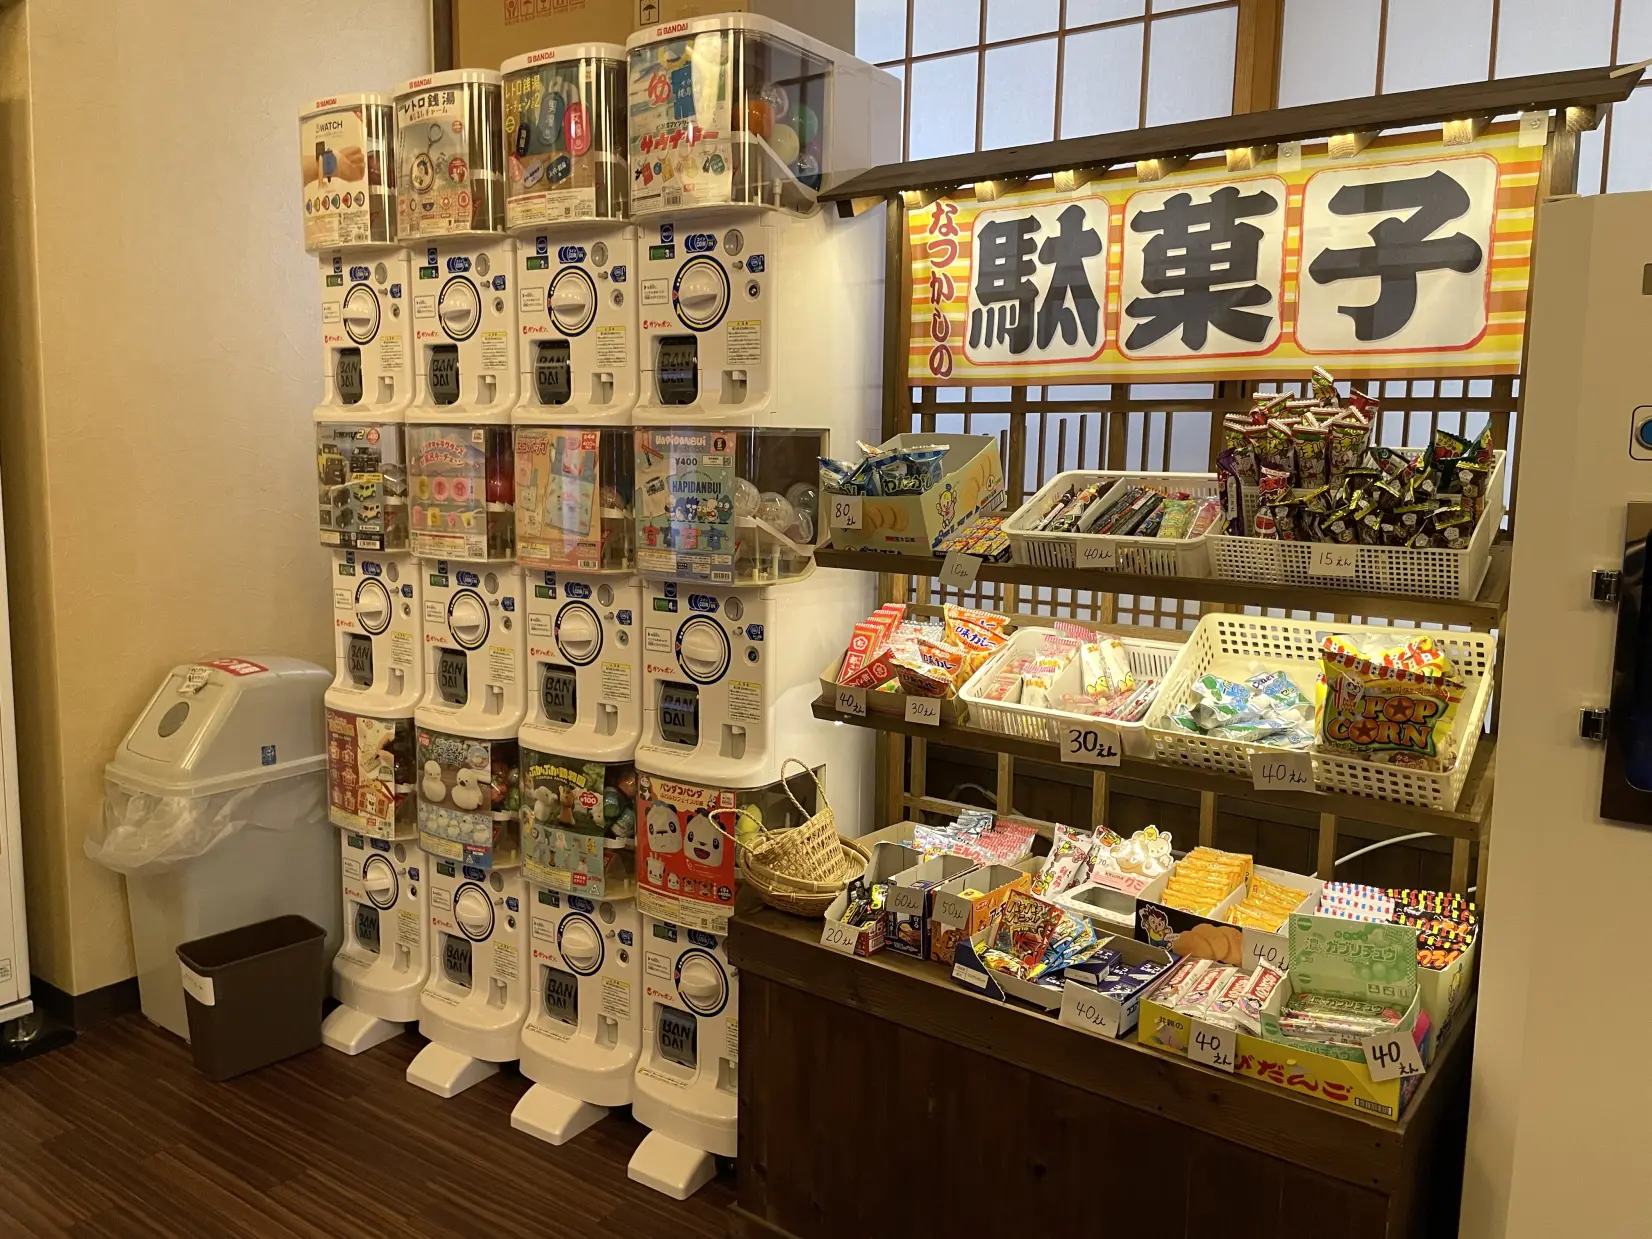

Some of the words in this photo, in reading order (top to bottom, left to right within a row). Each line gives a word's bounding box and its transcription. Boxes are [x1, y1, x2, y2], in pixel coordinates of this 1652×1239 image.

[663, 23, 688, 35] BANDAI
[533, 51, 555, 63] BANDAI
[647, 72, 672, 107] ゆ
[969, 169, 1483, 355] 駄菓子
[927, 200, 960, 379] なつかしの
[433, 358, 455, 373] BAN
[955, 625, 997, 648] 味カレー
[441, 660, 463, 676] BAN
[545, 676, 571, 694] BAN
[663, 711, 686, 727] DAI
[1361, 695, 1439, 726] POP
[1326, 717, 1432, 750] CORN
[660, 782, 704, 799] パンダコパンダ
[1124, 876, 1145, 891] グミ
[548, 978, 574, 999] BAN
[662, 1019, 692, 1041] BAN
